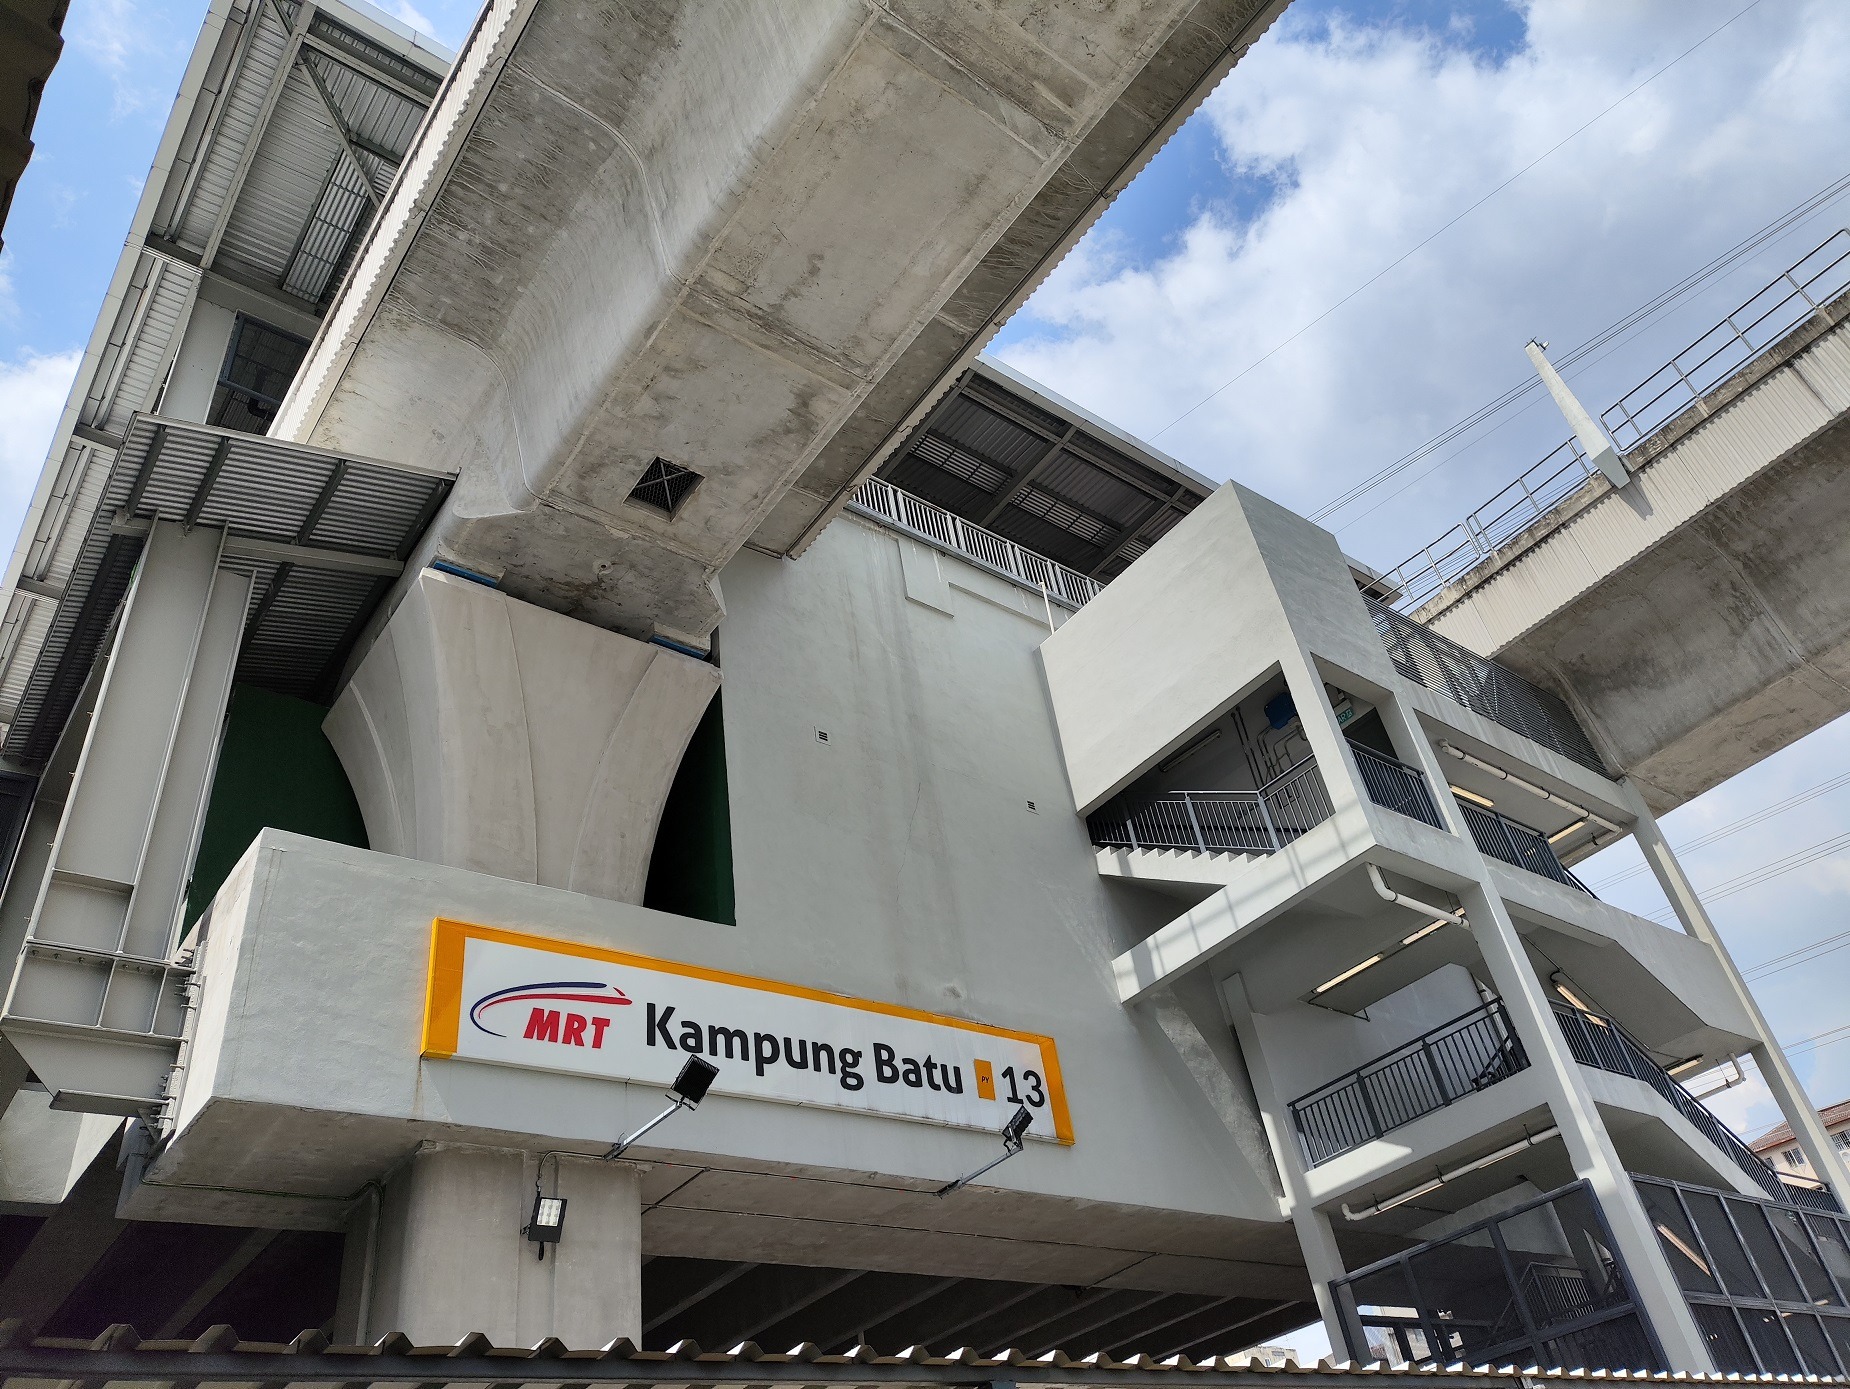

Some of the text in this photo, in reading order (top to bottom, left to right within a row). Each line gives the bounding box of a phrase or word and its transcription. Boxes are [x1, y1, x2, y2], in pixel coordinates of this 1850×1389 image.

[524, 1008, 612, 1049] MRT
[647, 1003, 1045, 1107] Kampung Batu PY 13
